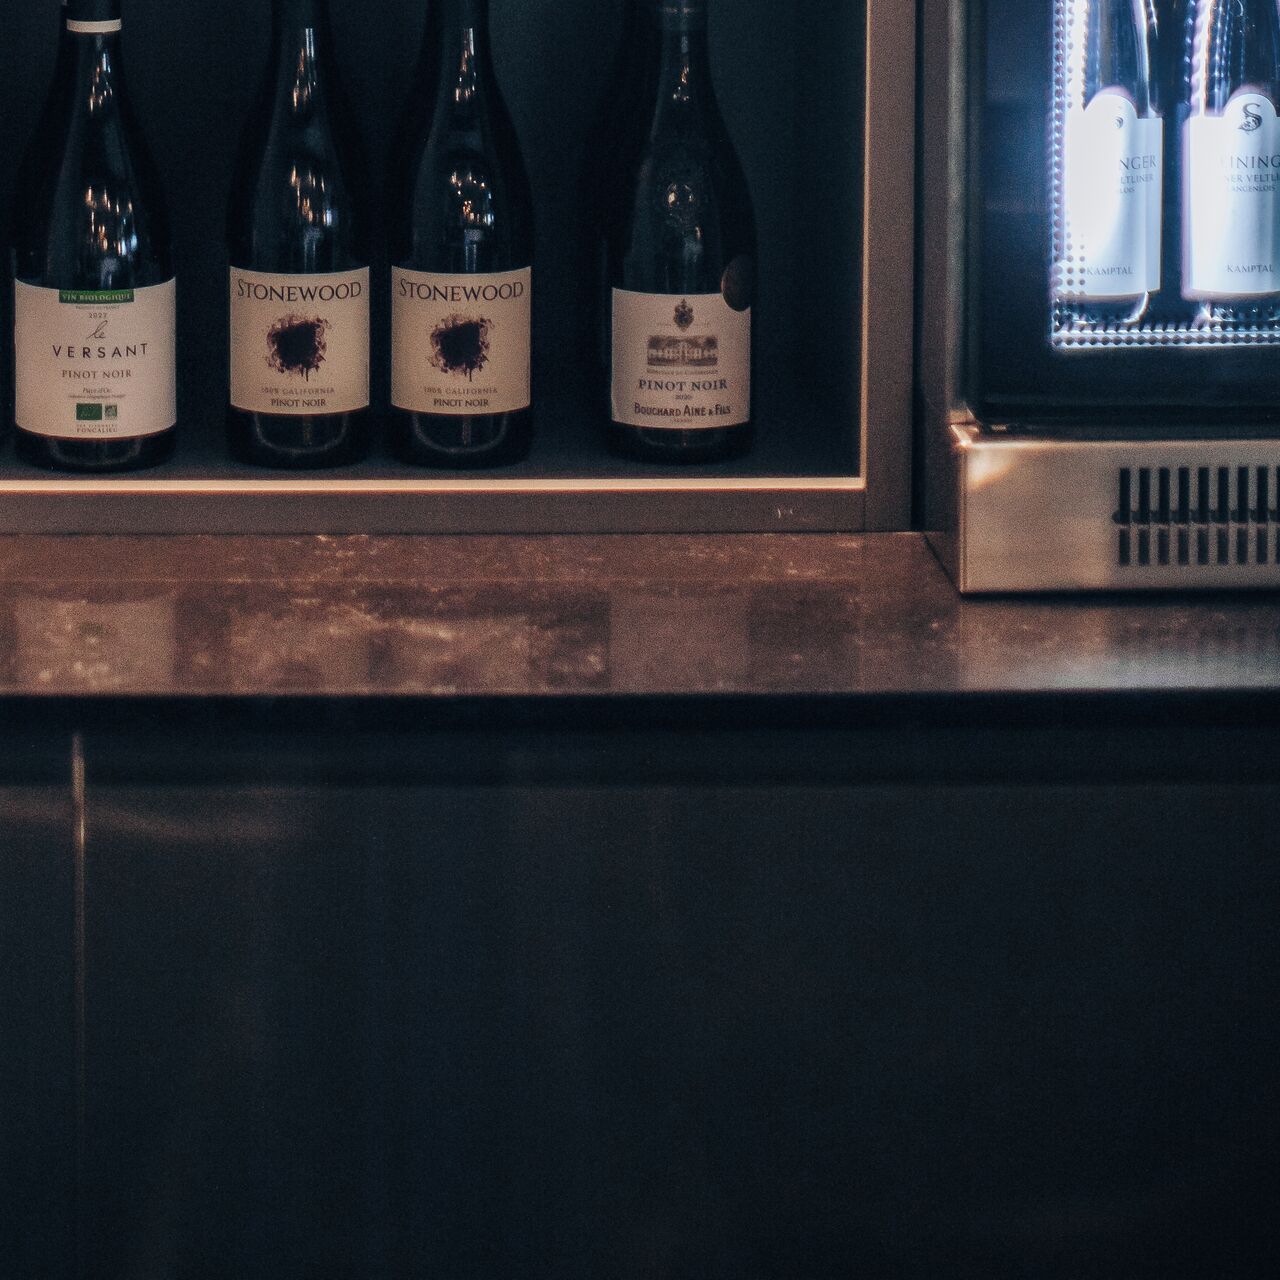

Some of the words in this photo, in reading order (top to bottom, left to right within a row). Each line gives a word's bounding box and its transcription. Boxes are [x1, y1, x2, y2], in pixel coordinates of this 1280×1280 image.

[1086, 267, 1134, 276] KAMPTAL
[1227, 264, 1274, 273] KAMPTAL
[237, 278, 362, 302] STONEWOOD
[399, 278, 524, 301] STONEWOOD
[79, 293, 131, 301] BIOLOGIQUE
[86, 320, 108, 340] le
[52, 342, 148, 358] VERSANT
[62, 369, 97, 379] PINOT
[102, 369, 132, 378] NOIR
[639, 379, 686, 391] PINOT
[691, 379, 728, 390] NOIR
[271, 398, 300, 407] PINOT
[302, 398, 326, 407] NOIR
[433, 399, 462, 407] PINOT
[464, 399, 489, 407] NOIR
